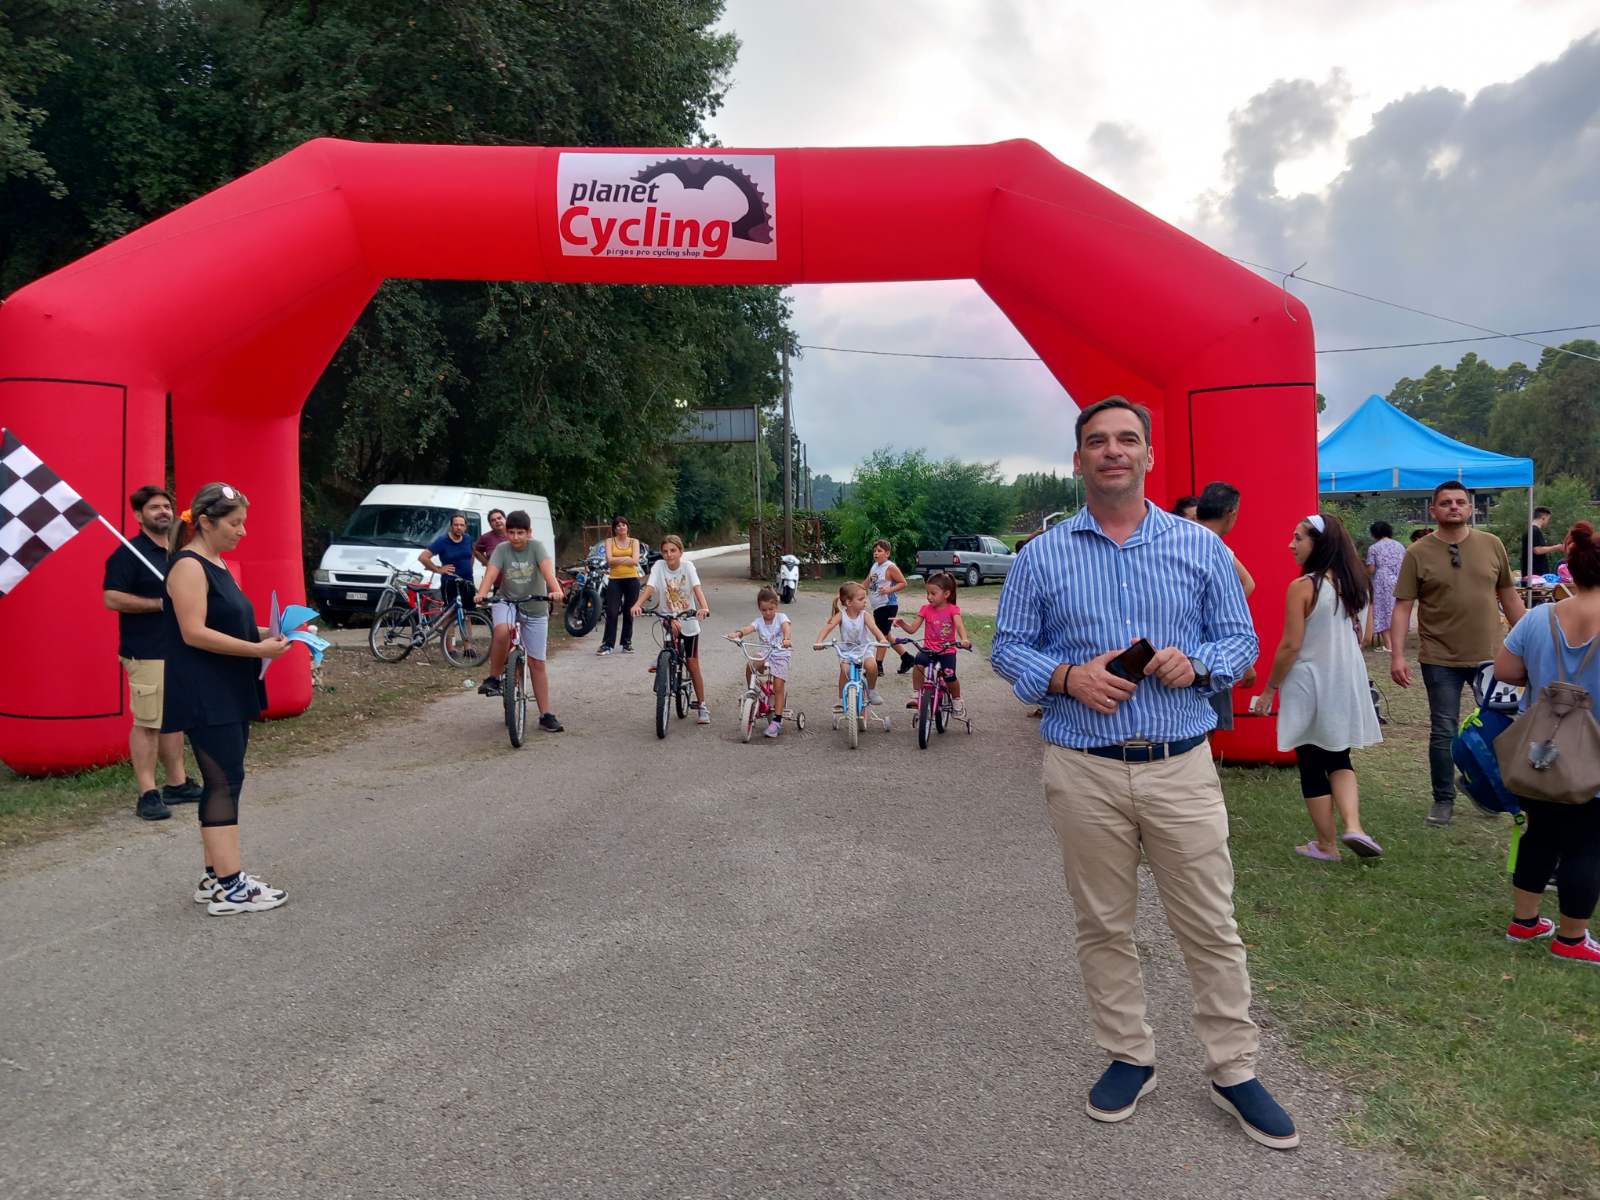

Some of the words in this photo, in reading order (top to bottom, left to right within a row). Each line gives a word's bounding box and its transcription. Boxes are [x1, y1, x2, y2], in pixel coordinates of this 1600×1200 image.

[569, 179, 660, 206] planet
[560, 205, 731, 257] Cycling
[652, 248, 680, 257] cycling
[682, 248, 700, 257] shop
